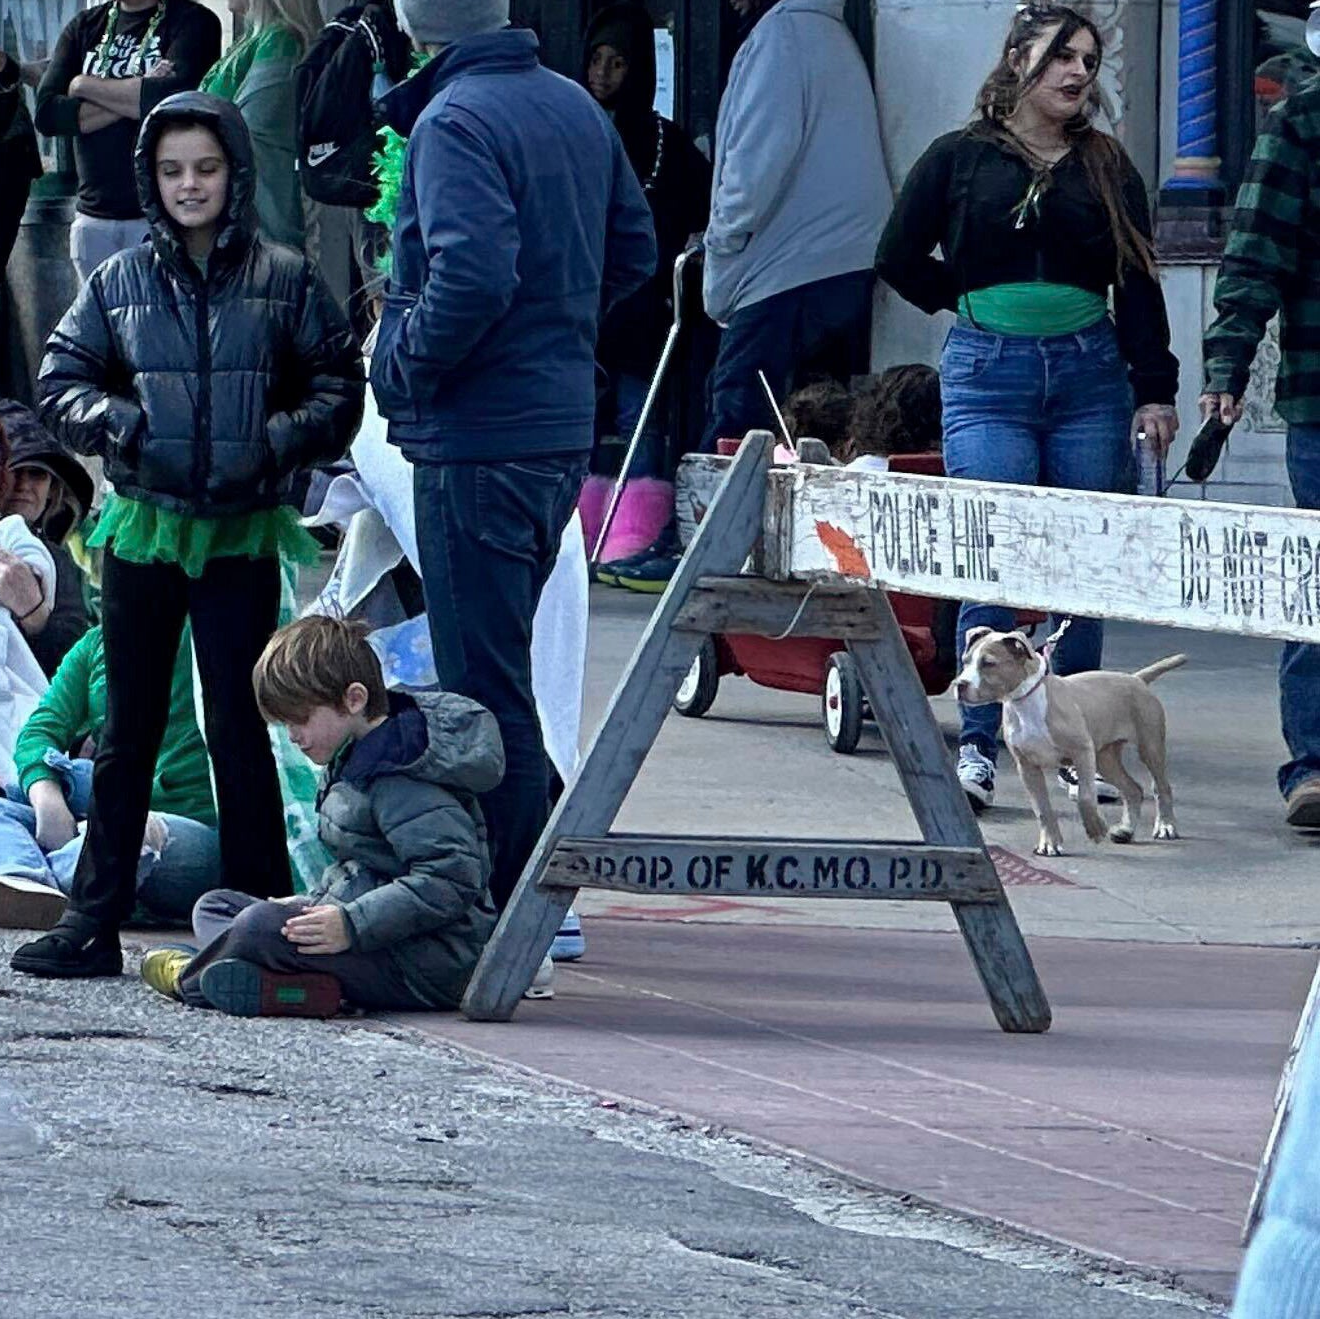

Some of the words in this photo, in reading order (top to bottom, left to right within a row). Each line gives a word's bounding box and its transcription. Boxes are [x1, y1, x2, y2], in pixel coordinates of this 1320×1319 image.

[868, 490, 941, 578] POLICE
[948, 497, 999, 582] LINE
[1179, 518, 1210, 609] DO
[1222, 526, 1268, 620] NOT
[687, 855, 733, 889] OF
